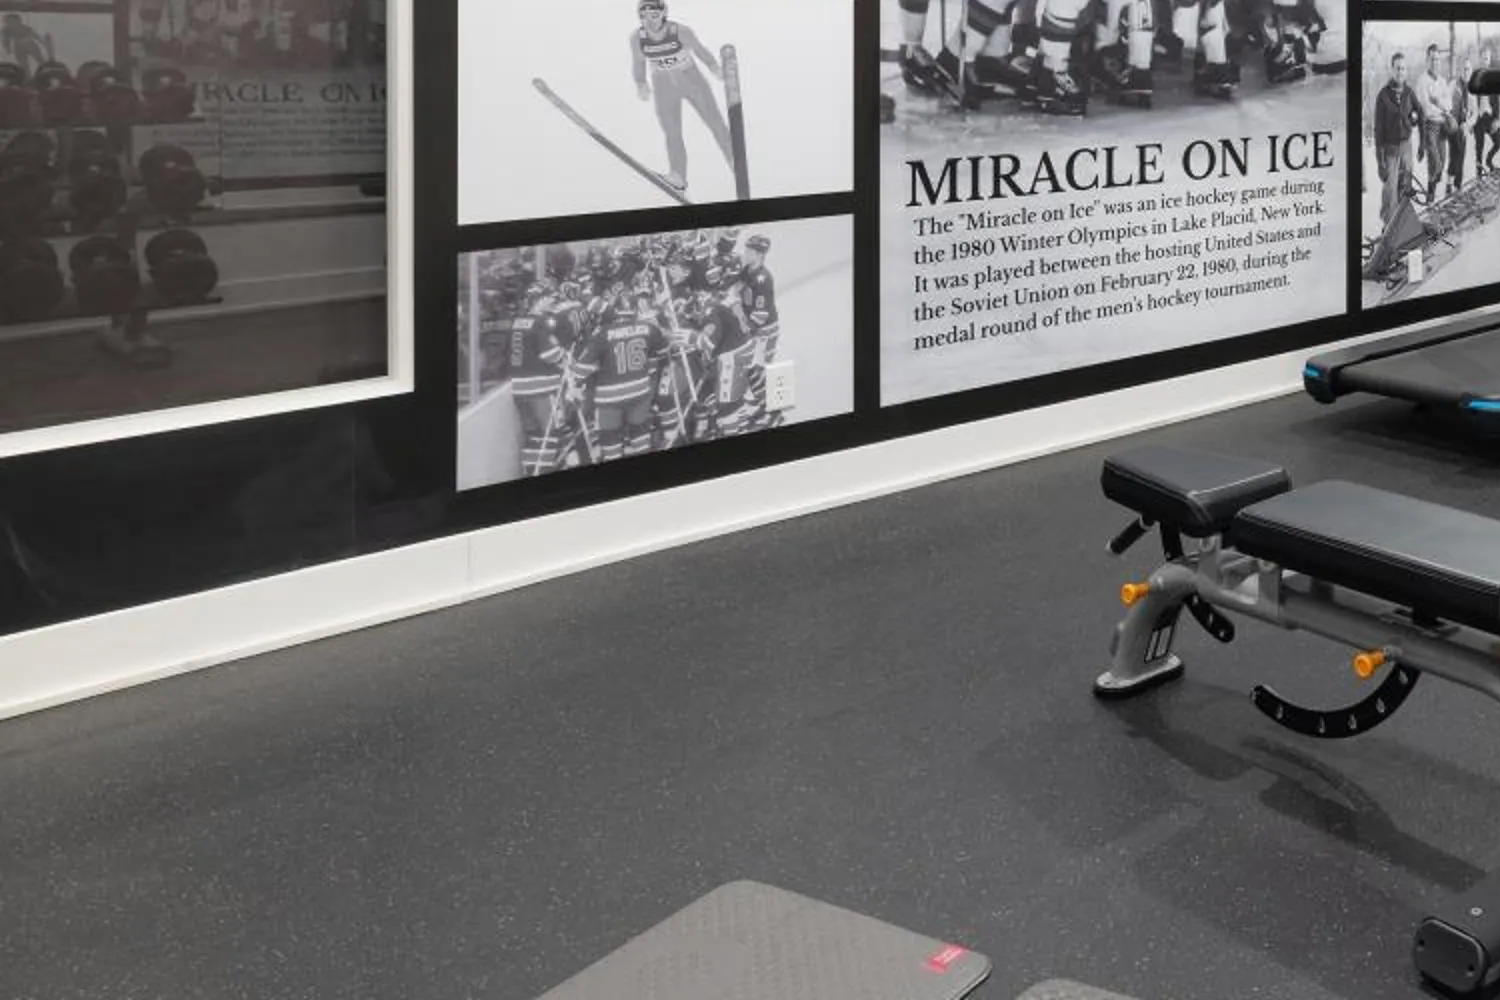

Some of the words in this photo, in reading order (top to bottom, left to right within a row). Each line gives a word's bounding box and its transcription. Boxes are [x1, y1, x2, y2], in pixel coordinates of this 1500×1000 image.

[905, 143, 1164, 207] MIRACLE
[1182, 137, 1252, 180] ON
[1267, 131, 1334, 173] ICE
[913, 216, 954, 236] The
[959, 207, 1037, 230] "Miracle
[1041, 207, 1064, 222] on
[1070, 199, 1100, 219] Ice"
[1104, 201, 1133, 215] was
[1137, 199, 1156, 212] an
[1161, 193, 1182, 209] ice
[1186, 188, 1236, 207] hockey
[1241, 186, 1277, 204] game
[1281, 180, 1325, 196] during
[914, 245, 945, 265] the
[951, 238, 995, 260] 1980
[1000, 233, 1064, 253] Winter
[1068, 221, 1147, 247] Olympics
[1152, 220, 1167, 235] in
[1171, 214, 1207, 233] Lake
[1261, 205, 1291, 221] New
[914, 275, 928, 293] It
[934, 273, 969, 290] was
[974, 259, 1035, 290] played
[1040, 254, 1111, 275] between
[1116, 247, 1140, 265] the
[1145, 240, 1201, 260] hosting
[1205, 231, 1252, 252] United
[1256, 228, 1295, 246] States
[1297, 221, 1321, 240] and
[914, 301, 945, 321] the
[951, 292, 1008, 316] Soviet
[1013, 283, 1070, 306] Union
[1073, 282, 1096, 297] on
[1101, 269, 1173, 293] February
[1203, 258, 1239, 277] 1980,
[1243, 251, 1288, 269] during
[1291, 246, 1311, 262] the
[914, 321, 975, 350] medal
[981, 312, 1037, 339] round
[1042, 307, 1062, 328] of
[1065, 305, 1092, 324] the
[1096, 295, 1143, 319] men's
[1147, 288, 1202, 311] hockey
[1205, 275, 1291, 301] tournament.
